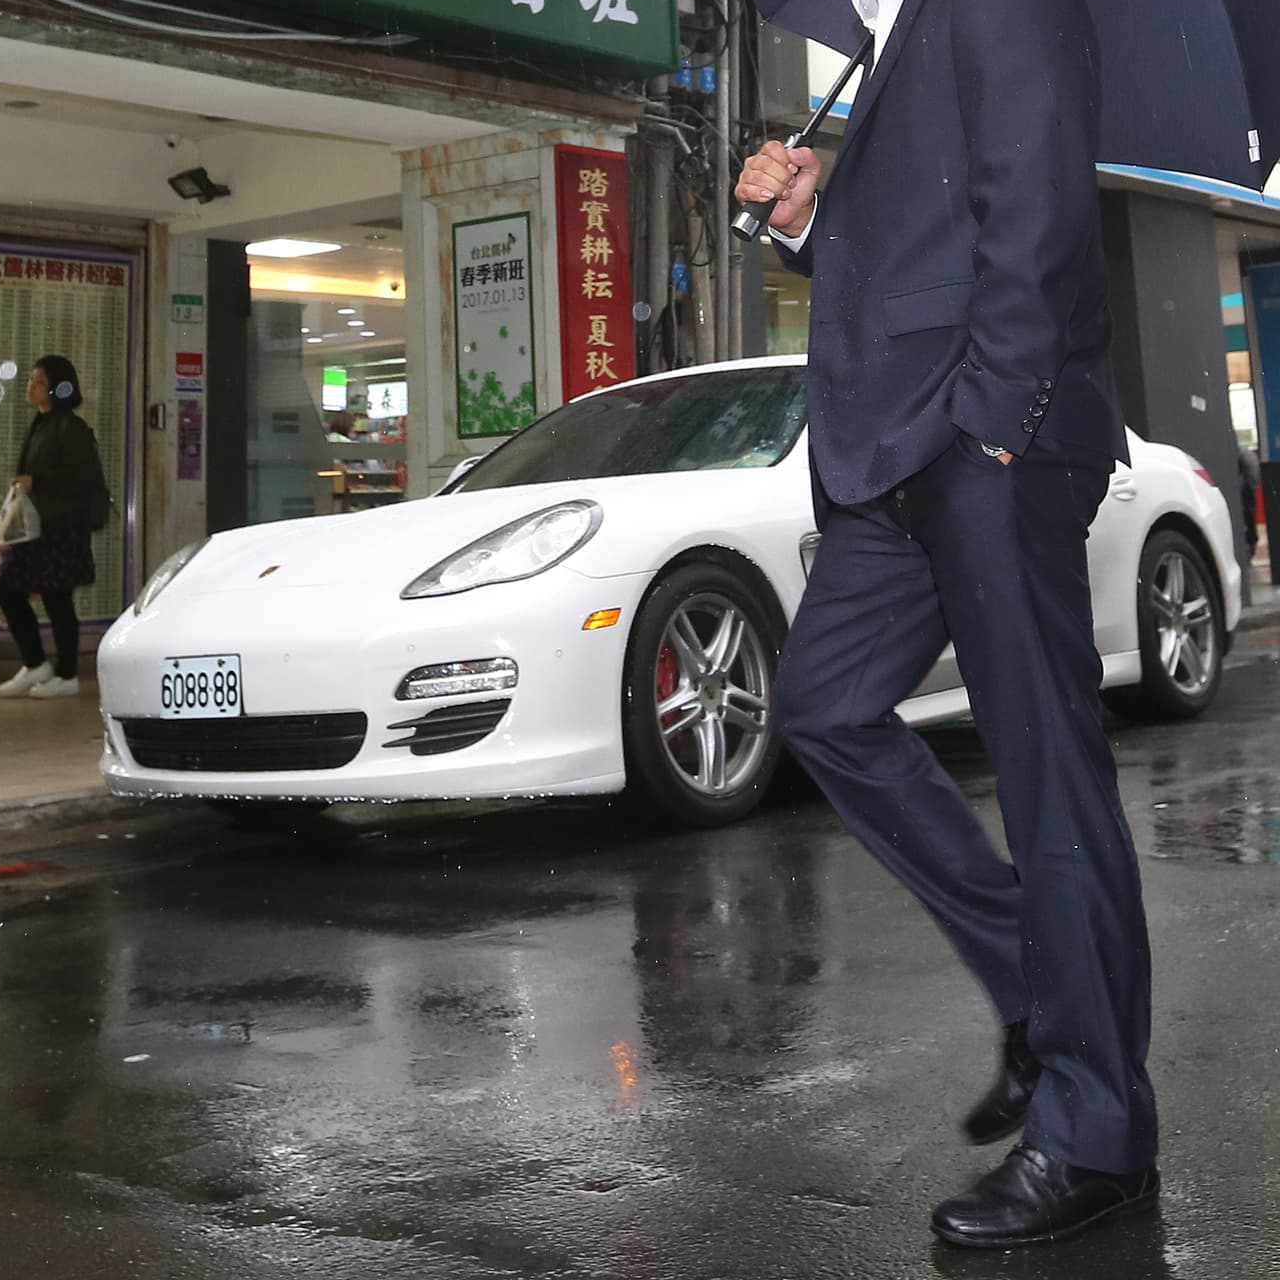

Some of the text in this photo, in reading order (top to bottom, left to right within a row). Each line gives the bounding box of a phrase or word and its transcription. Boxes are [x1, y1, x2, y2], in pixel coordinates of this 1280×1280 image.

[470, 242, 512, 260] 台北儒林
[460, 258, 525, 288] 春季新班
[578, 168, 619, 391] 踏實耕耘 夏秋
[462, 286, 526, 309] 2017.01.13
